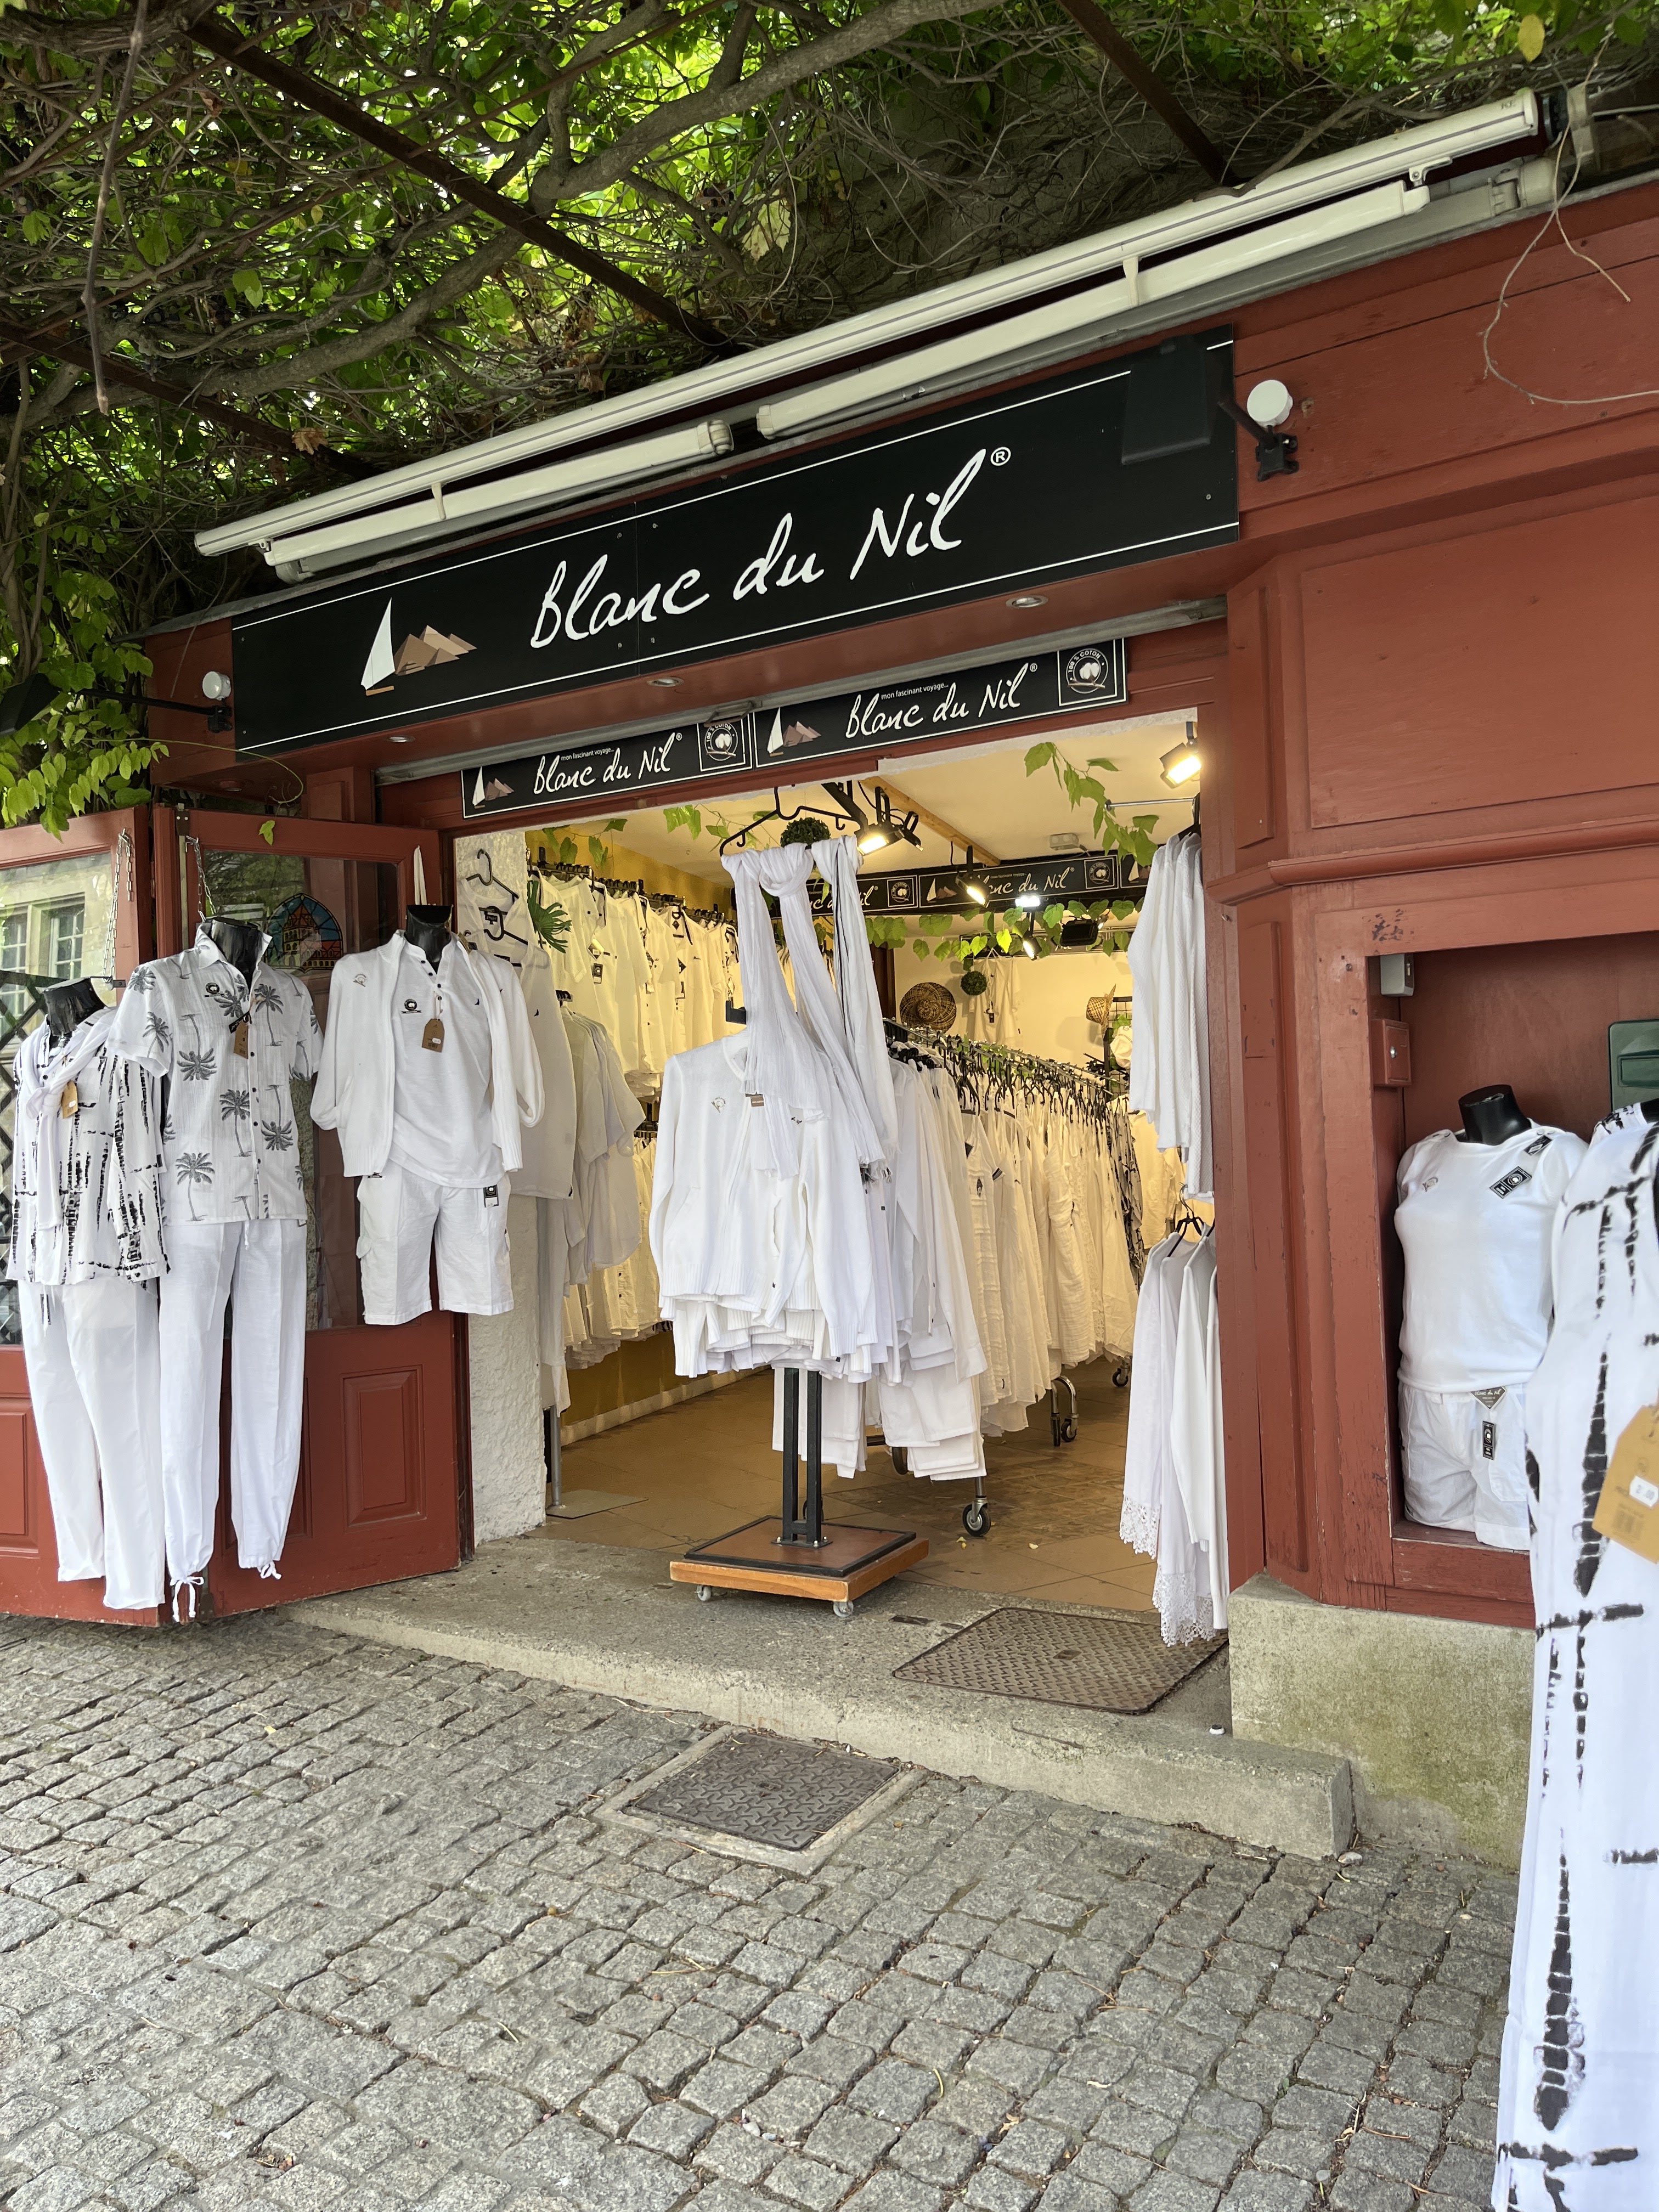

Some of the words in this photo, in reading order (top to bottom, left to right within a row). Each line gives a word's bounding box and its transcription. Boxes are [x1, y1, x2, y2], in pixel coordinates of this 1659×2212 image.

[531, 554, 710, 648] Blanc
[733, 512, 824, 600] du
[1080, 650, 1101, 659] COTON
[896, 686, 922, 698] fascinant
[845, 693, 923, 738] Blanc
[933, 682, 969, 723] du
[573, 749, 594, 759] fascinant
[534, 755, 596, 794] Blanc
[603, 748, 631, 782] du
[1018, 873, 1038, 892] du
